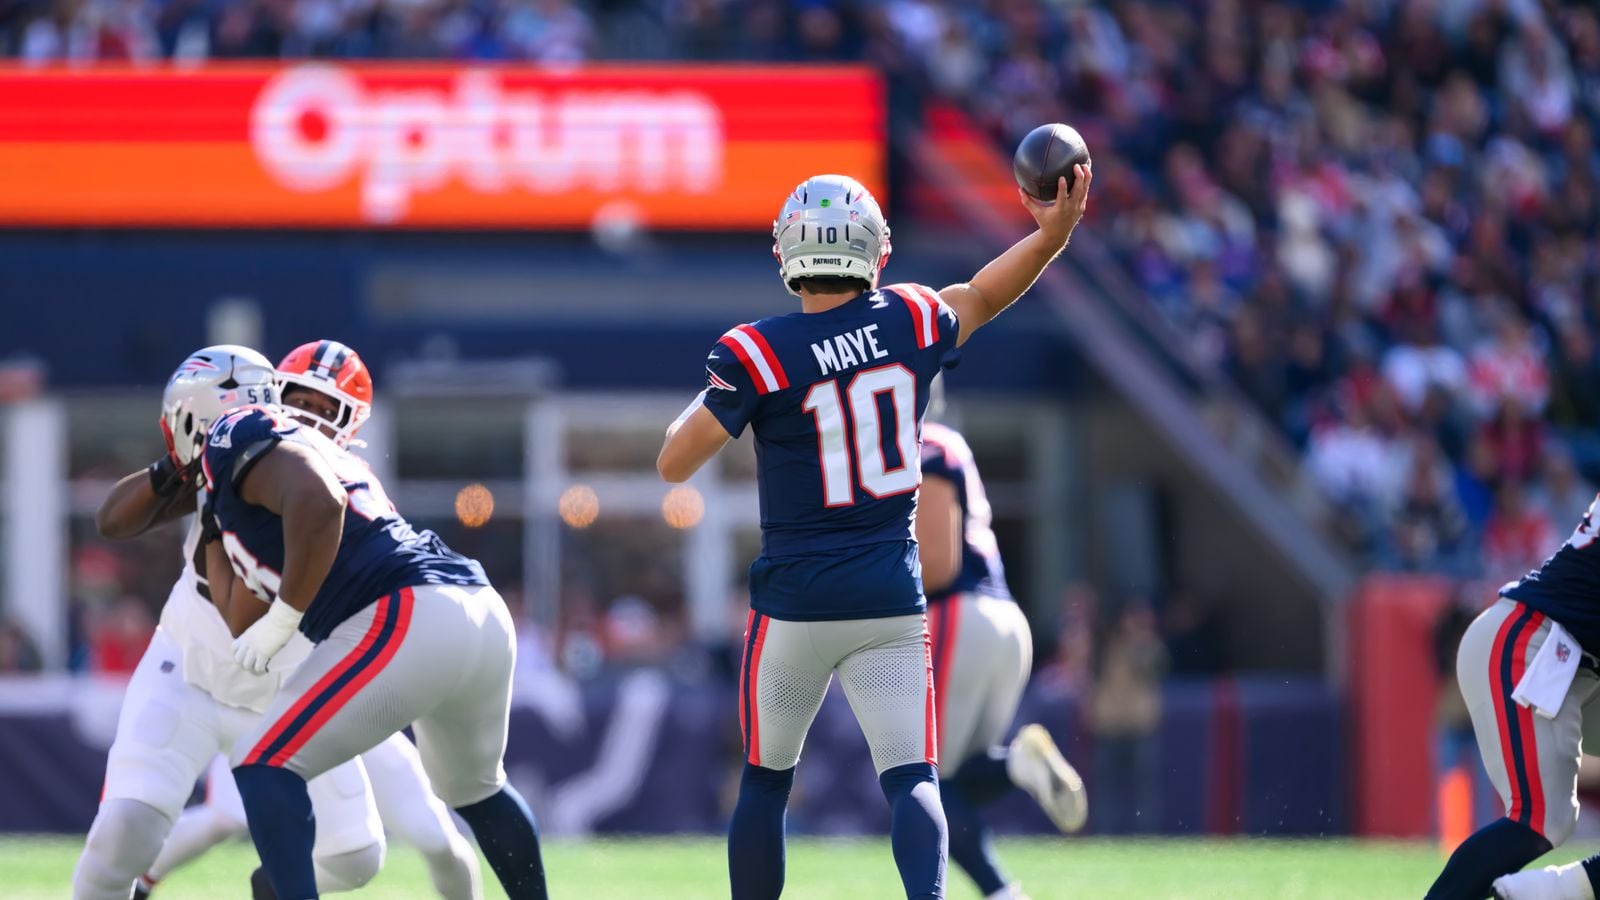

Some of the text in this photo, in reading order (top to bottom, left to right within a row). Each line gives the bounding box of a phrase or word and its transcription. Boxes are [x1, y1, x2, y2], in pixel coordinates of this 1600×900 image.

[250, 63, 722, 222] Optum
[817, 227, 837, 244] 10
[813, 258, 842, 266] PATRIOTS
[810, 323, 889, 376] MAYE
[247, 388, 272, 404] 58
[801, 362, 921, 509] 10
